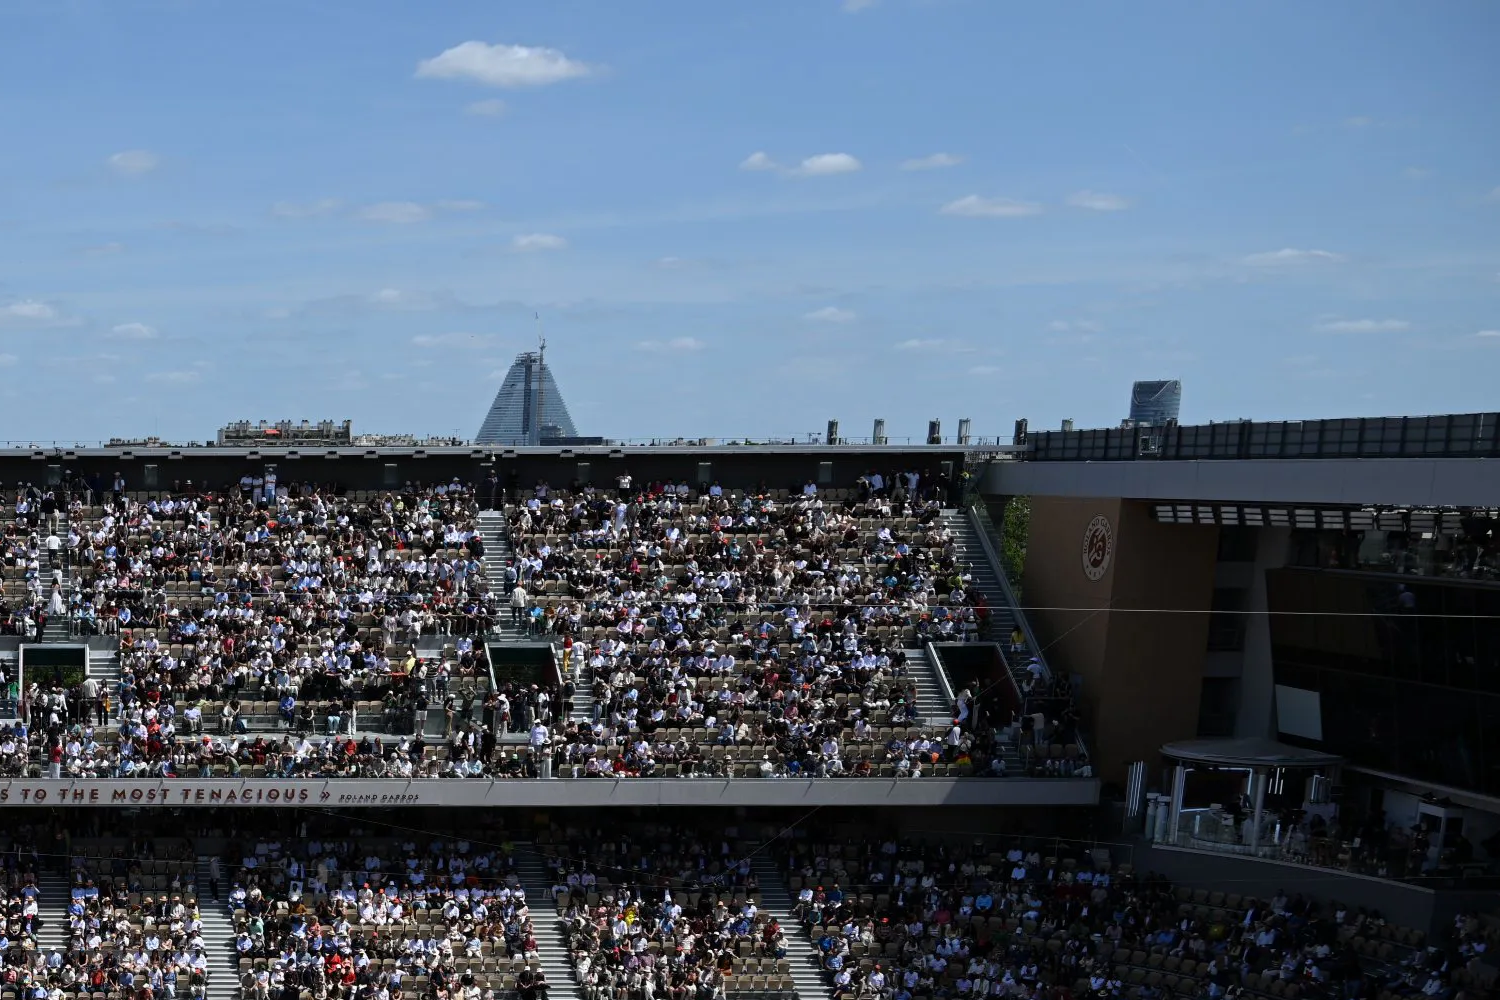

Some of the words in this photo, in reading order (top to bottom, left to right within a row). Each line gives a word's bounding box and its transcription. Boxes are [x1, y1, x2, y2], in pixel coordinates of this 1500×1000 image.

[22, 788, 47, 800] TO
[59, 788, 99, 800] THE
[113, 788, 170, 800] MOST
[182, 788, 309, 800] TENACIOUS
